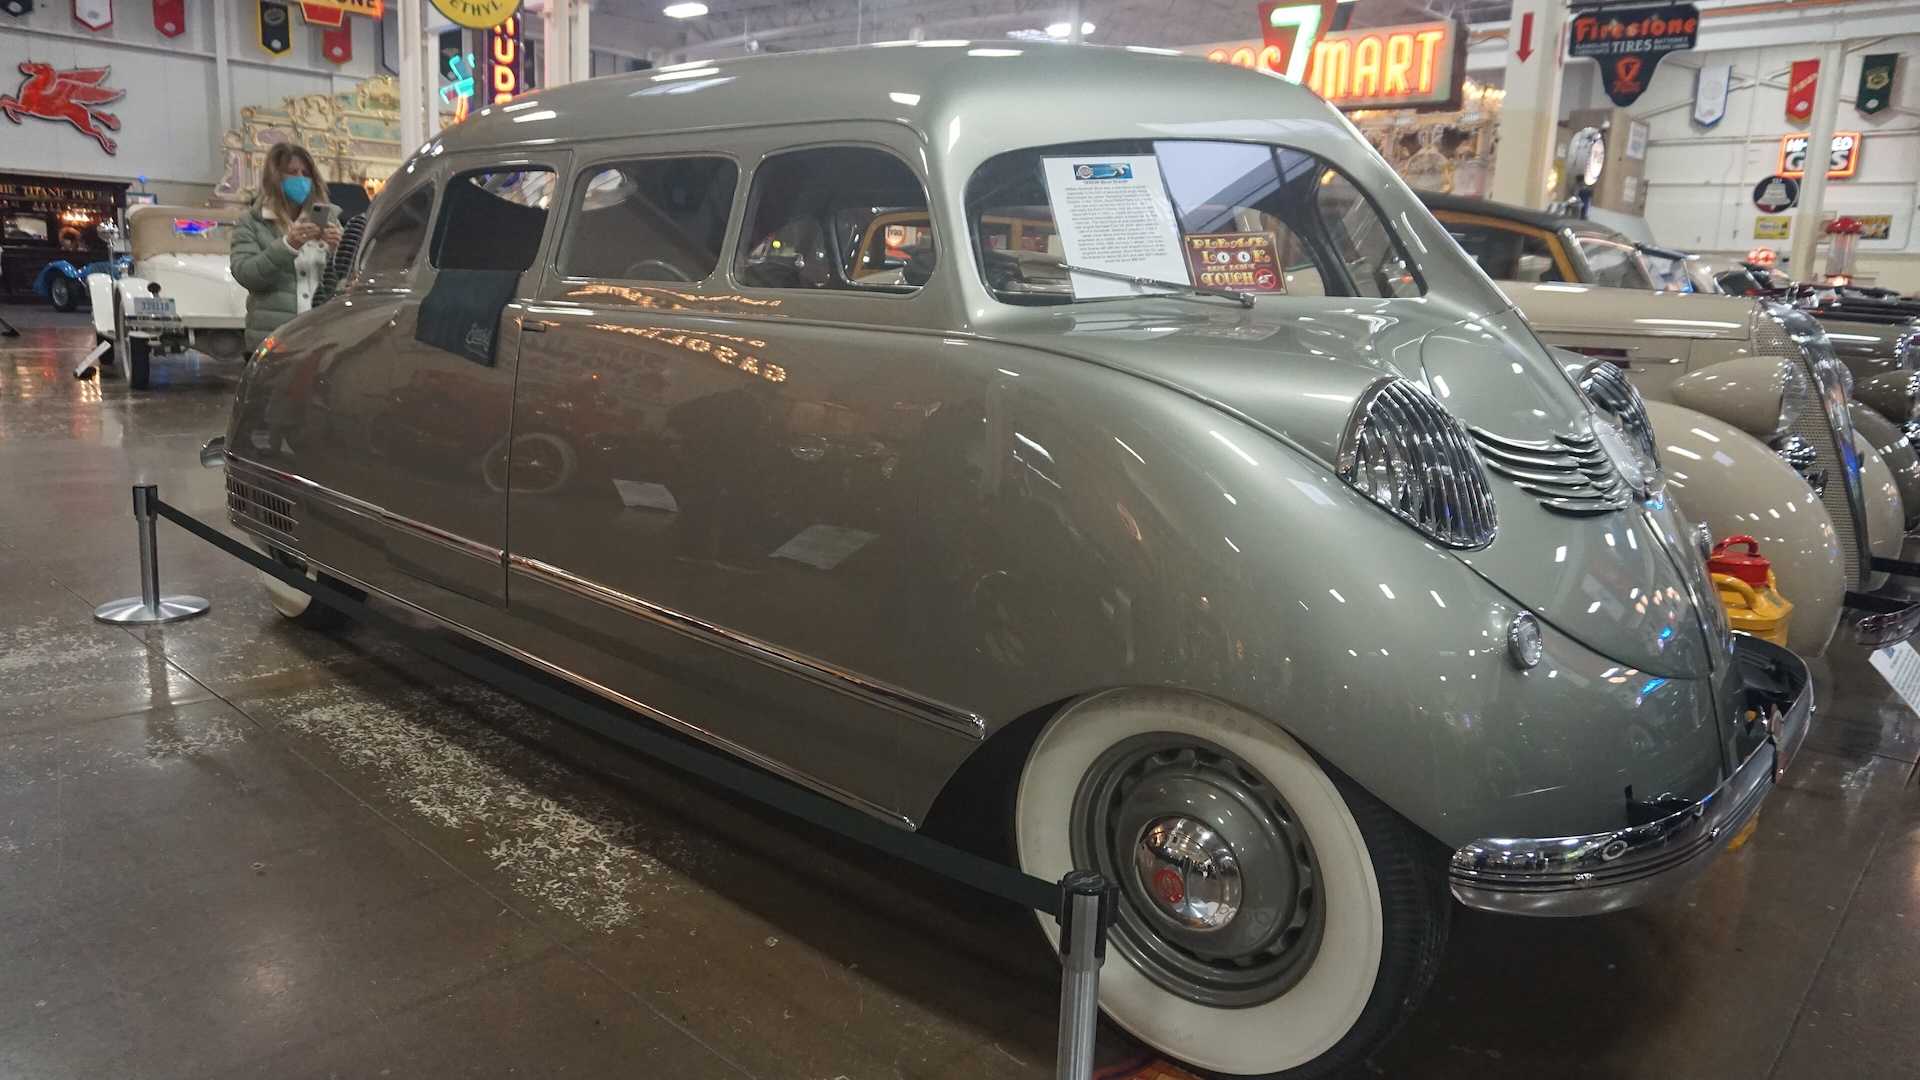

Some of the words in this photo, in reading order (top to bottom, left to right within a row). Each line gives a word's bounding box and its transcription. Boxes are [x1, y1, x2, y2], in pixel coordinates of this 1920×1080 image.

[1574, 15, 1697, 44] Firestone
[1270, 4, 1322, 86] 7
[1611, 38, 1653, 54] TIRES
[1311, 30, 1445, 99] MART
[1785, 150, 1850, 171] GS
[1192, 236, 1269, 249] PLEASE
[1200, 271, 1256, 287] TOUCH
